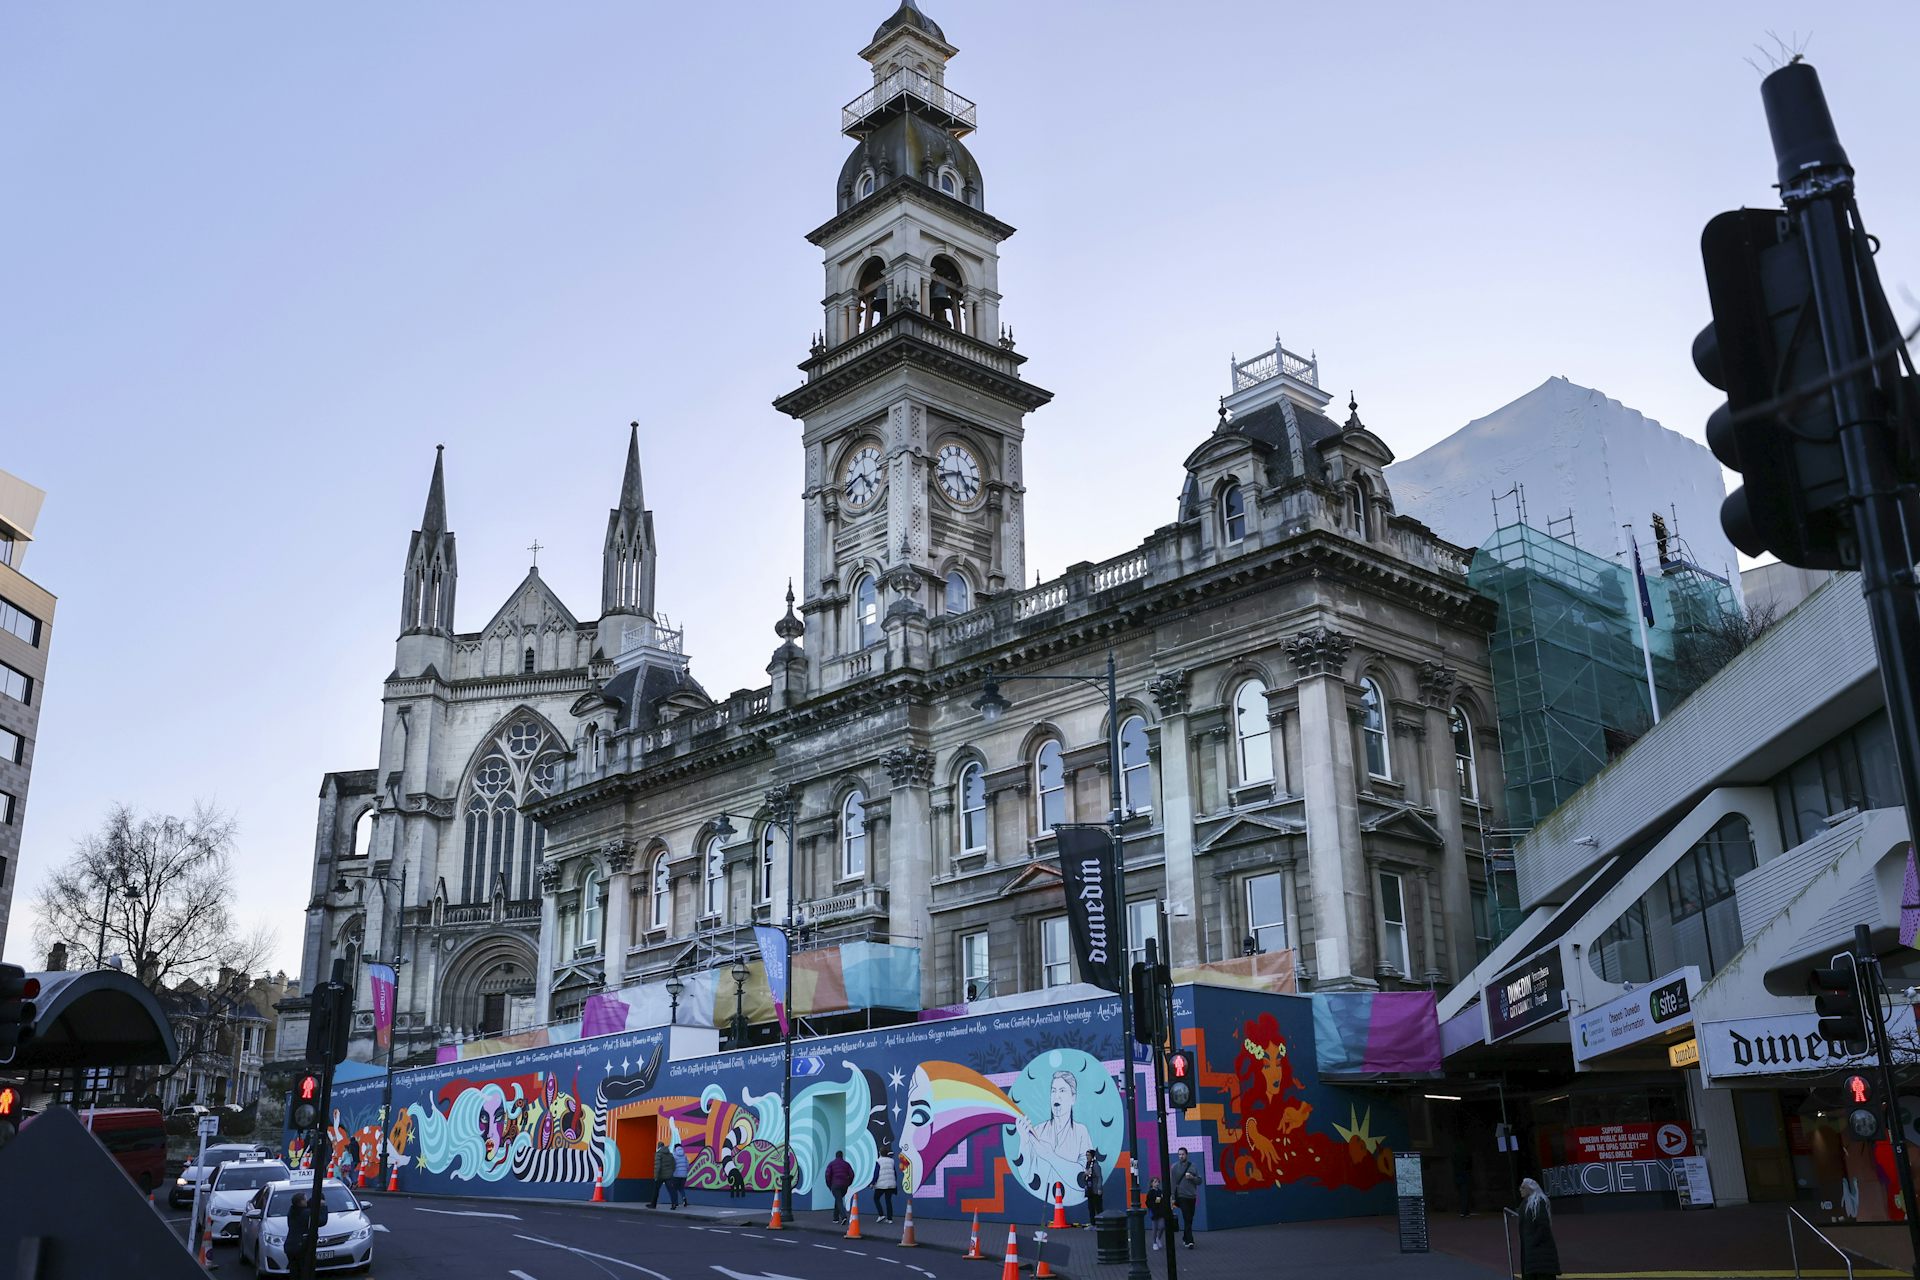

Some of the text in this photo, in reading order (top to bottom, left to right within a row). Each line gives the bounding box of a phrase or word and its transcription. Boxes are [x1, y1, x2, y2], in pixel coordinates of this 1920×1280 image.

[1074, 857, 1108, 965] dunedin
[1506, 974, 1533, 1004] DUNEDIN
[1660, 989, 1678, 1016] site
[1063, 1006, 1092, 1024] Knowledge
[1601, 1125, 1624, 1135] SUPPORT
[1600, 1133, 1617, 1144] PUBLIC
[1618, 1133, 1628, 1143] ART
[1627, 1132, 1649, 1143] GALLERY
[1584, 1143, 1596, 1153] JOIN
[1596, 1143, 1606, 1152] THE
[1619, 1141, 1640, 1151] SOCIETY
[1896, 1145, 1902, 1154] 5
